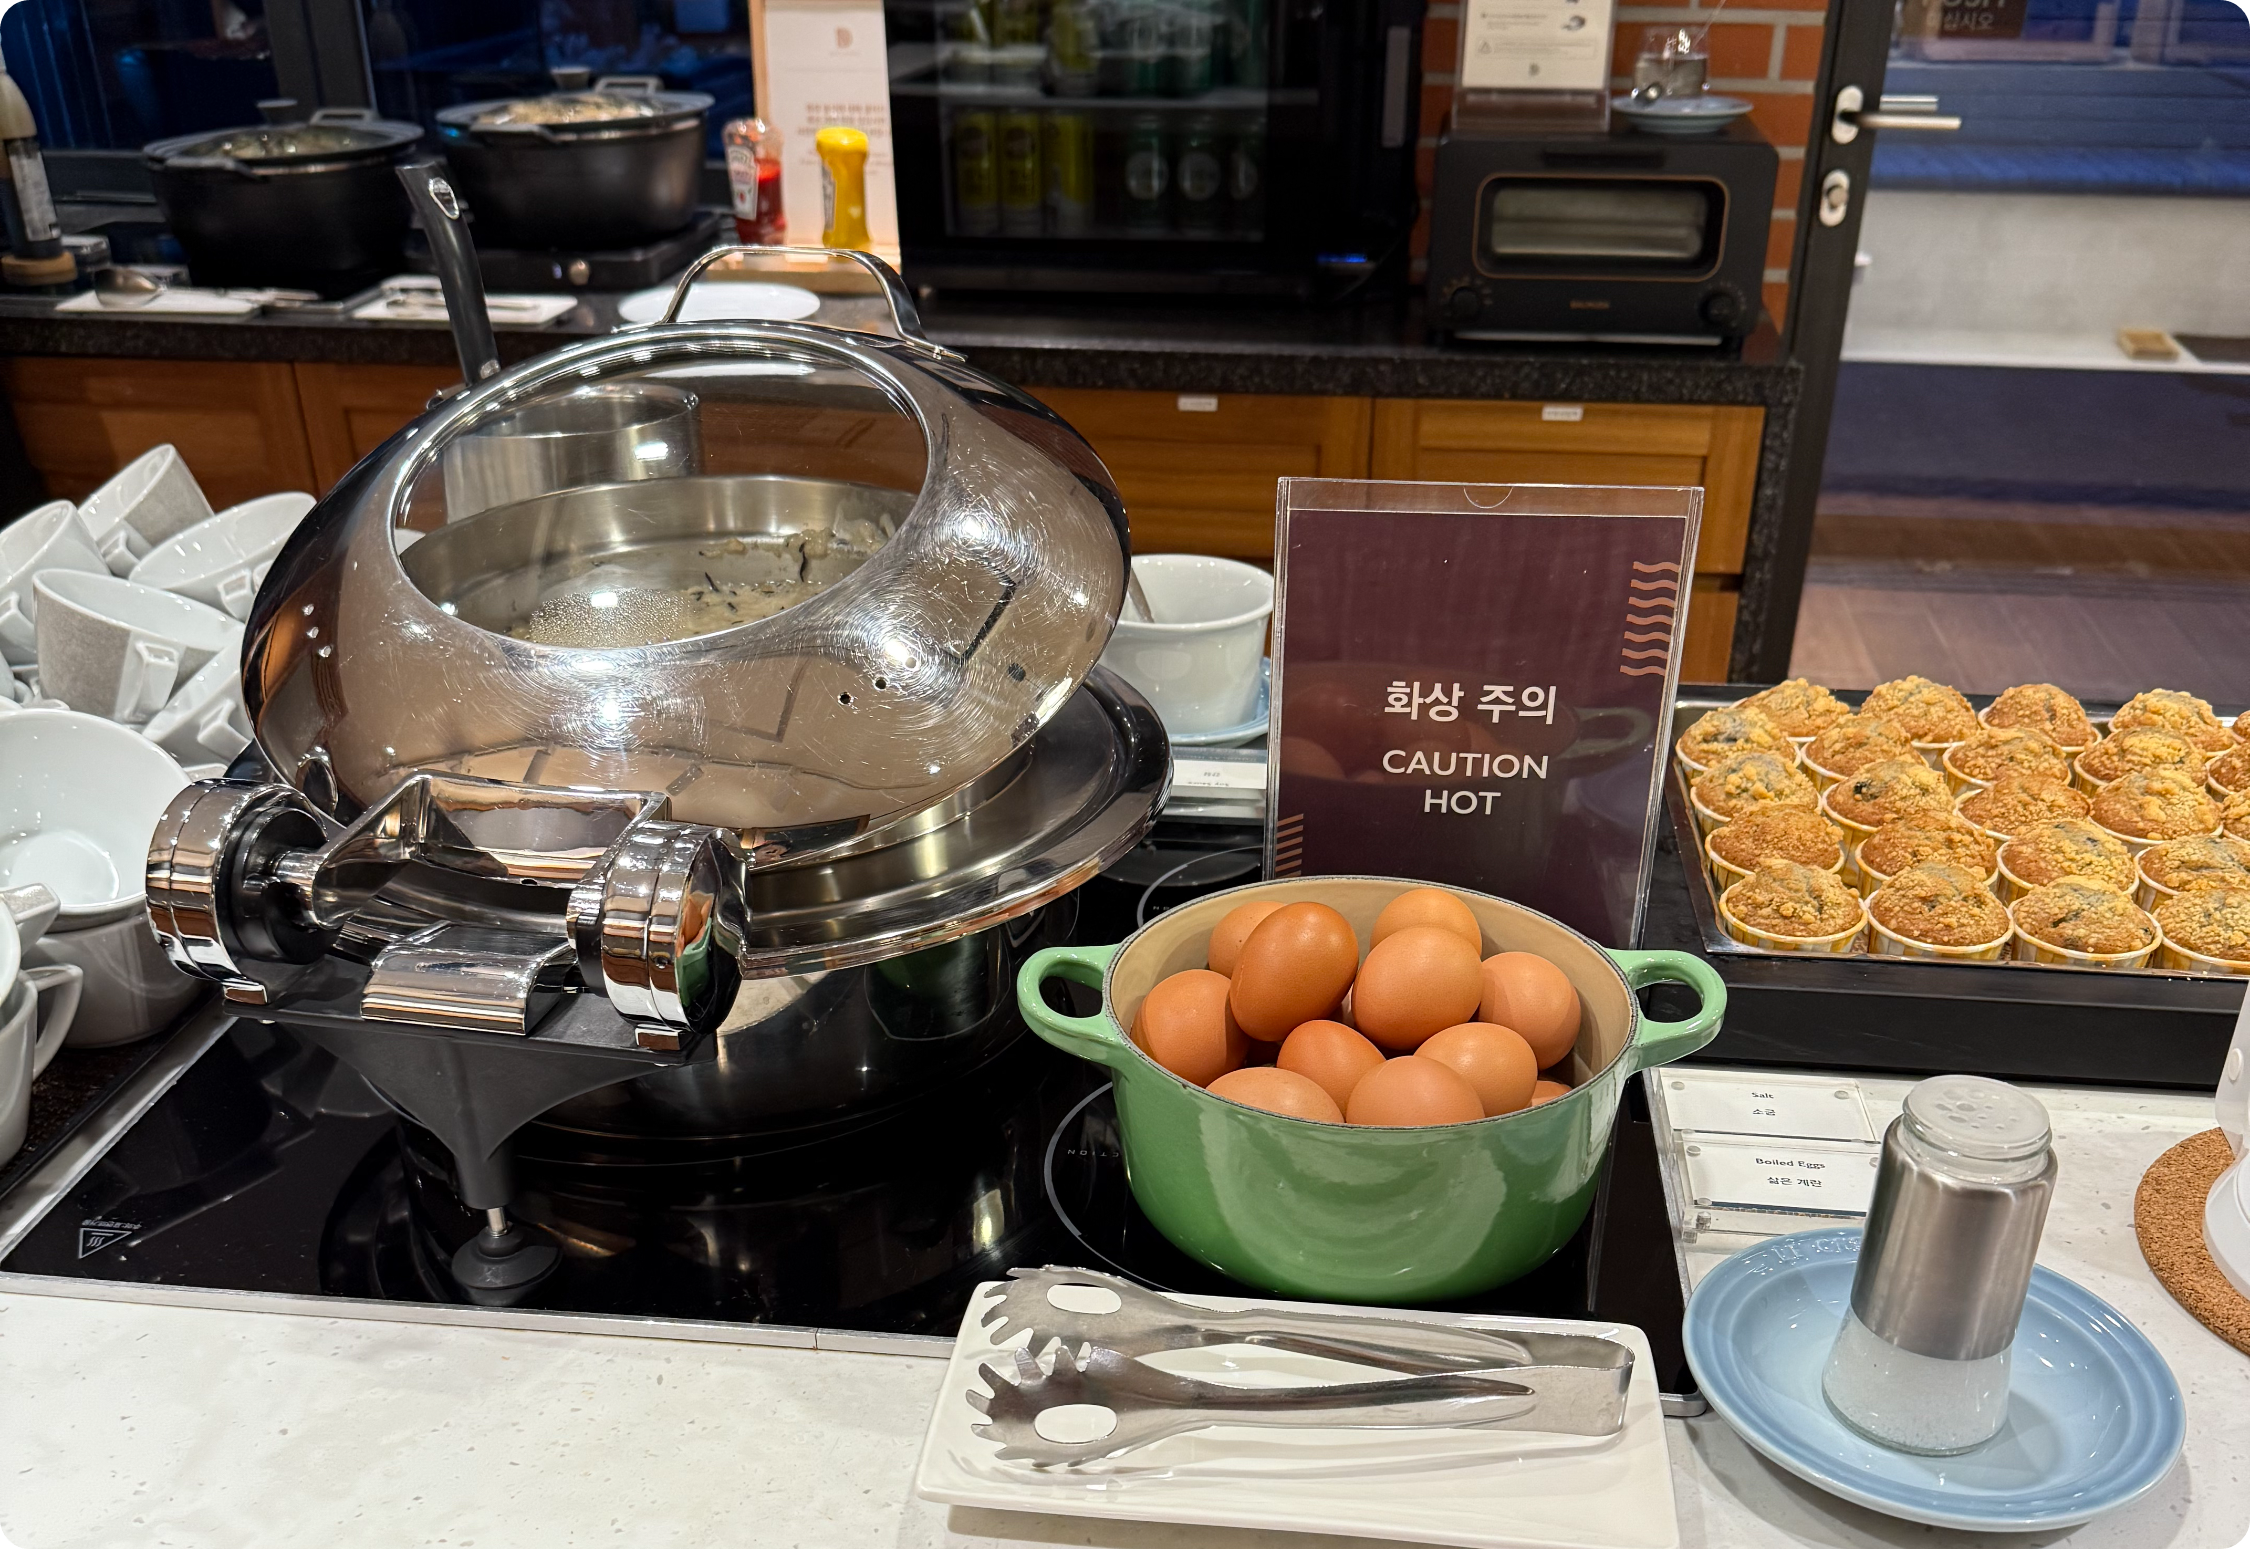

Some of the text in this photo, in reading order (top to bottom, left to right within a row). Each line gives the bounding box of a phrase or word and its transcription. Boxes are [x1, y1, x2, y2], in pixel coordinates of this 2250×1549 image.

[1939, 10, 1995, 31] 십시오
[1384, 681, 1557, 725] 화상 주의
[1382, 750, 1549, 779] CAUTION
[1423, 789, 1502, 815] HOT
[1752, 1108, 1776, 1116] 소금
[1067, 1149, 1120, 1157] CTION
[1755, 1157, 1826, 1170] Boiled Eggs
[1767, 1176, 1823, 1188] 삶은 계란
